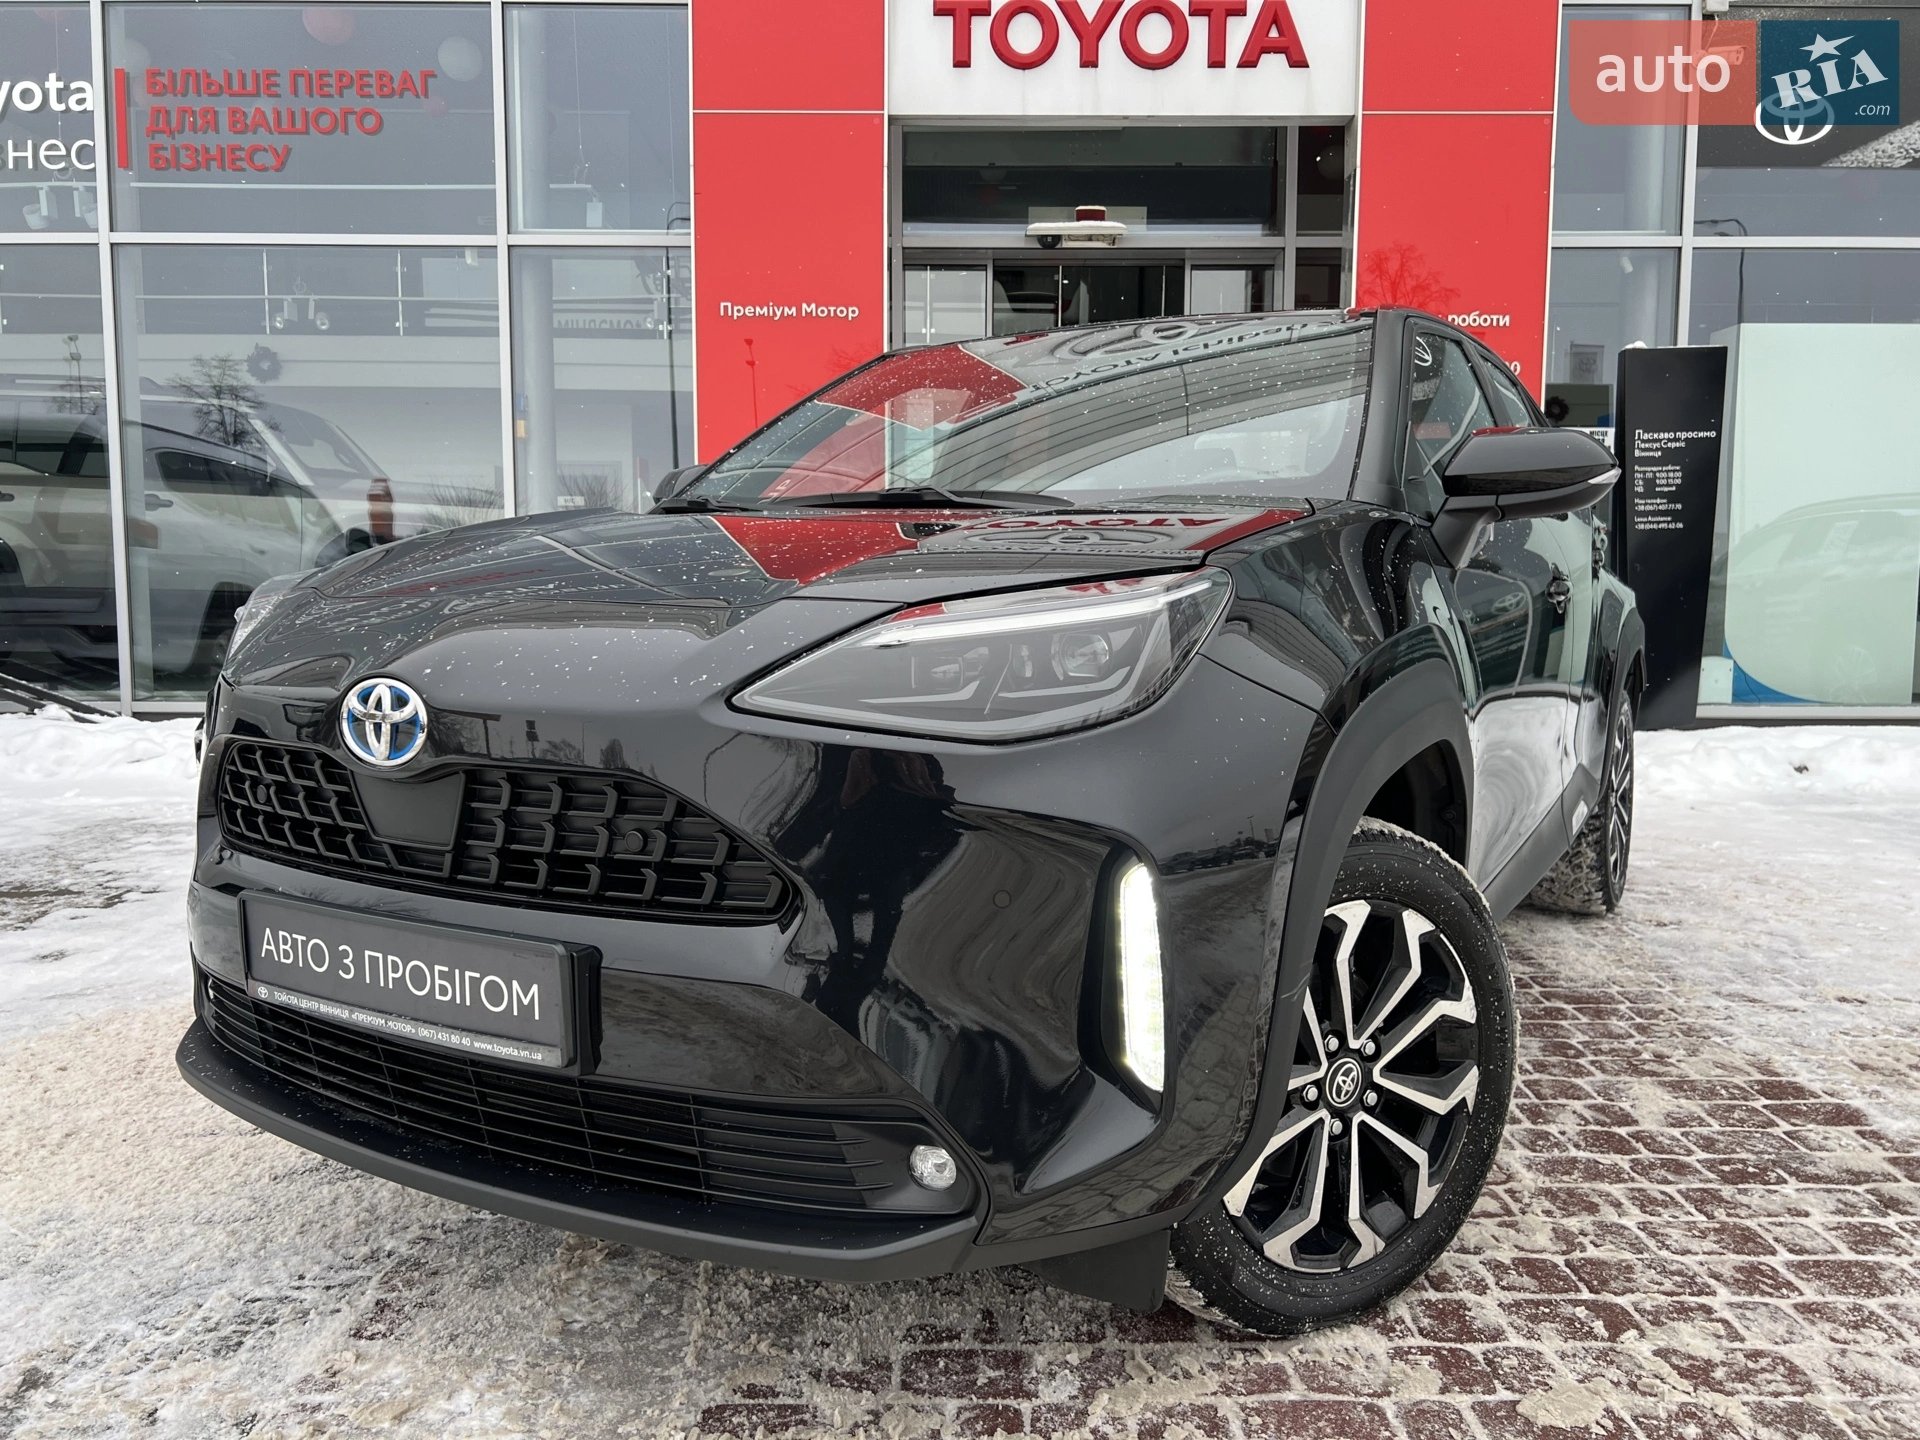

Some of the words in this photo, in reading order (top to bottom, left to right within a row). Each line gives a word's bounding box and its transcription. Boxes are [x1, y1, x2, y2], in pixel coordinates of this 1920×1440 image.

[933, 0, 1310, 70] TOYOTA
[145, 68, 280, 97] БІЛЬШЕ
[289, 69, 435, 98] ПЕРЕВАГ
[145, 106, 217, 138] ДЛЯ
[227, 106, 382, 134] ВАШОГО
[148, 143, 290, 171] БІЗНЕСУ
[719, 302, 797, 321] Преміум
[801, 302, 860, 321] Мотор
[1634, 429, 1675, 440] Ласкаво
[1675, 430, 1717, 441] просимо
[1634, 440, 1661, 450] Лексус
[1661, 439, 1686, 449] Сервіс
[1634, 449, 1662, 458] Вінниця
[261, 926, 330, 974] АВТО
[337, 944, 356, 980] З
[363, 949, 540, 1021] ПРОБІГОМ
[273, 990, 299, 1006] ТОЙОТА
[298, 998, 319, 1010] ЦЕНТР
[319, 1003, 350, 1019] ВІННИЦЯ
[386, 1019, 416, 1034] МОТОР»
[418, 1026, 437, 1040] (067)
[437, 1031, 451, 1043] 431
[450, 1034, 460, 1045] 80
[461, 1036, 471, 1047] 40
[473, 1040, 542, 1060] www.toyota.vn.ua
